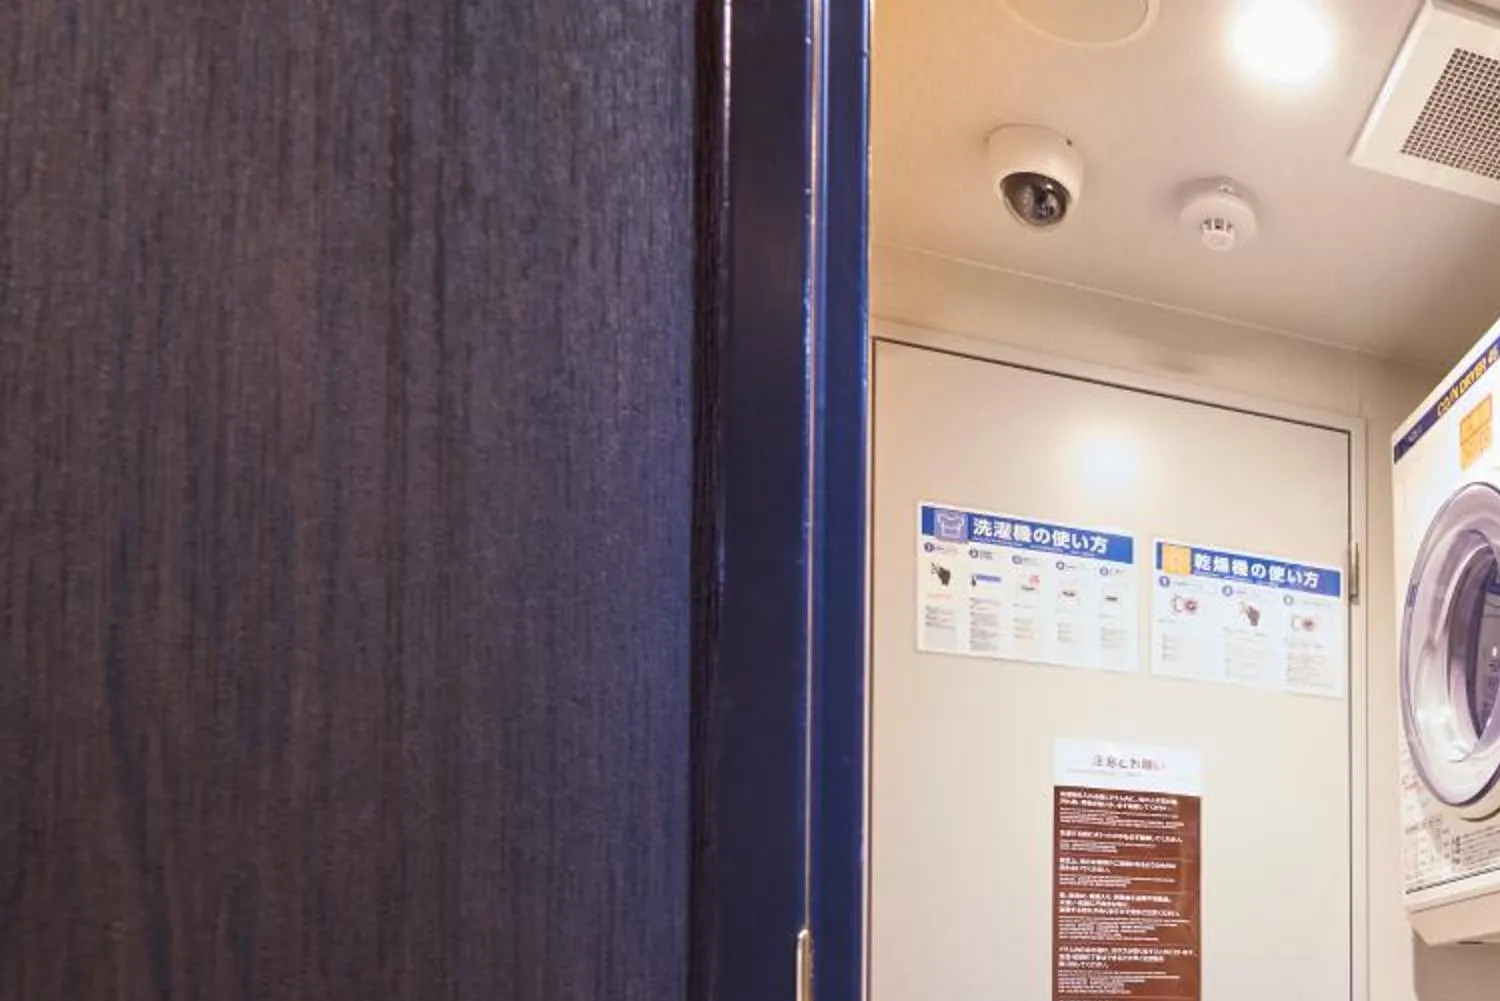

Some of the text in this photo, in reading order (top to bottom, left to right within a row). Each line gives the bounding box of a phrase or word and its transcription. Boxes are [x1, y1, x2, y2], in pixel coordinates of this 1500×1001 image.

[973, 518, 1108, 554] 洗濯機の使い方
[1194, 553, 1320, 588] 乾燥機の使い方
